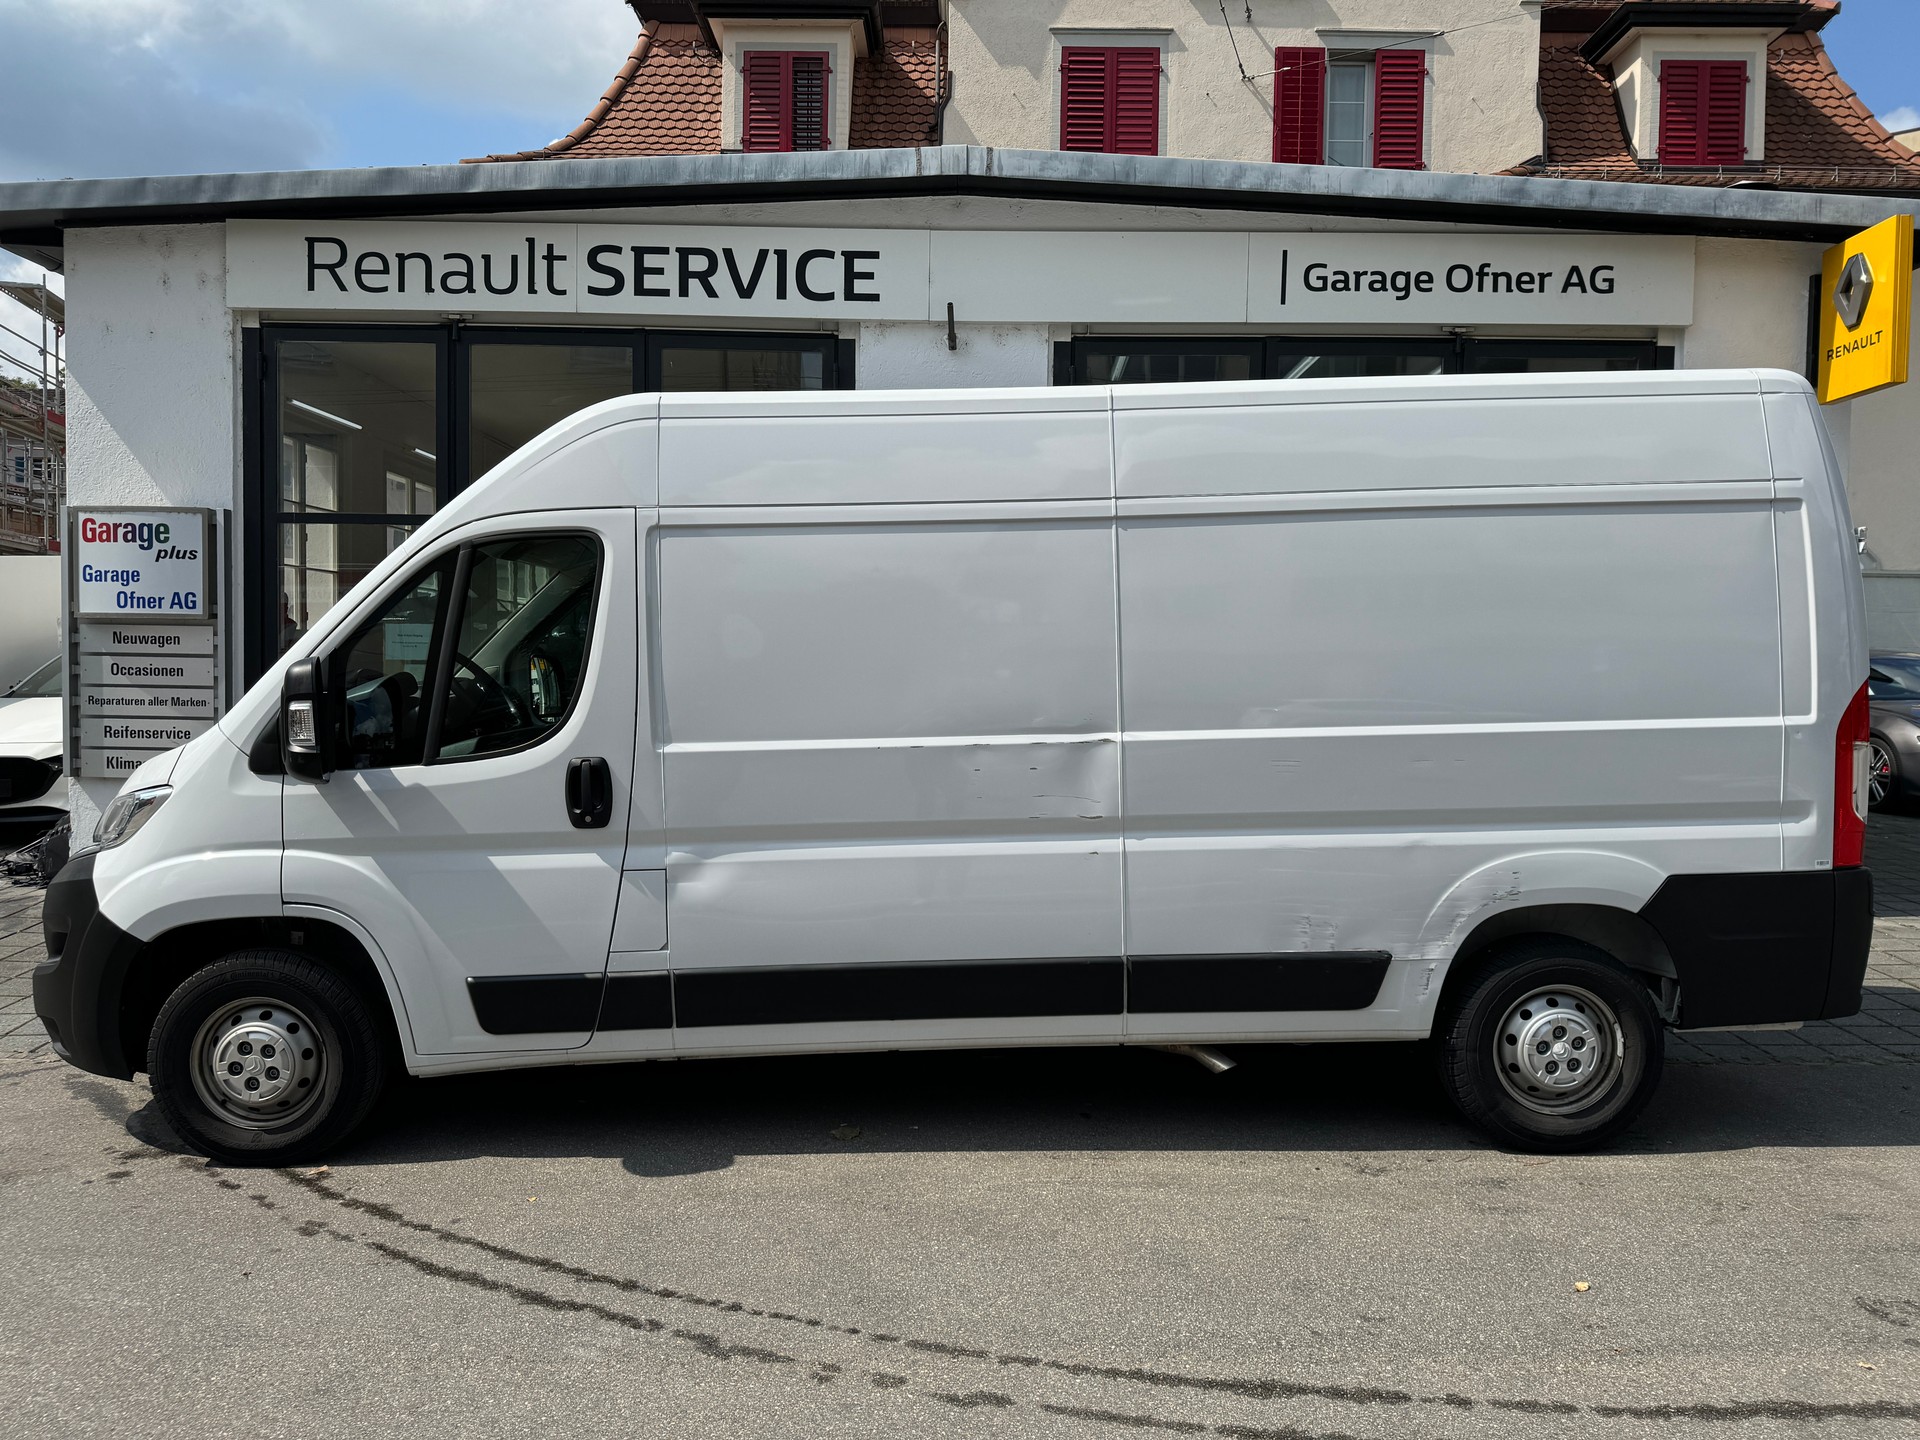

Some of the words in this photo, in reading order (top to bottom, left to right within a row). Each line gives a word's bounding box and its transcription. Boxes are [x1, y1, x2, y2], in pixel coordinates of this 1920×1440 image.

[304, 236, 568, 296] Renault
[586, 245, 881, 303] SERVICE
[1303, 263, 1434, 301] Garage
[1445, 263, 1553, 294] Ofner
[1560, 265, 1615, 295] AG
[1826, 330, 1884, 362] RENAULT
[81, 517, 171, 551] Garage
[154, 545, 199, 563] plus
[82, 564, 141, 587] Garage
[116, 590, 165, 610] Ofner
[169, 591, 197, 610] AG
[112, 630, 181, 647] Neuwagen
[110, 662, 184, 678] Occasionen
[87, 695, 146, 708] Reparaturen
[147, 696, 169, 707] aller
[170, 697, 207, 708] Marken
[103, 725, 191, 740] Reifenservice
[106, 756, 145, 770] Klima
